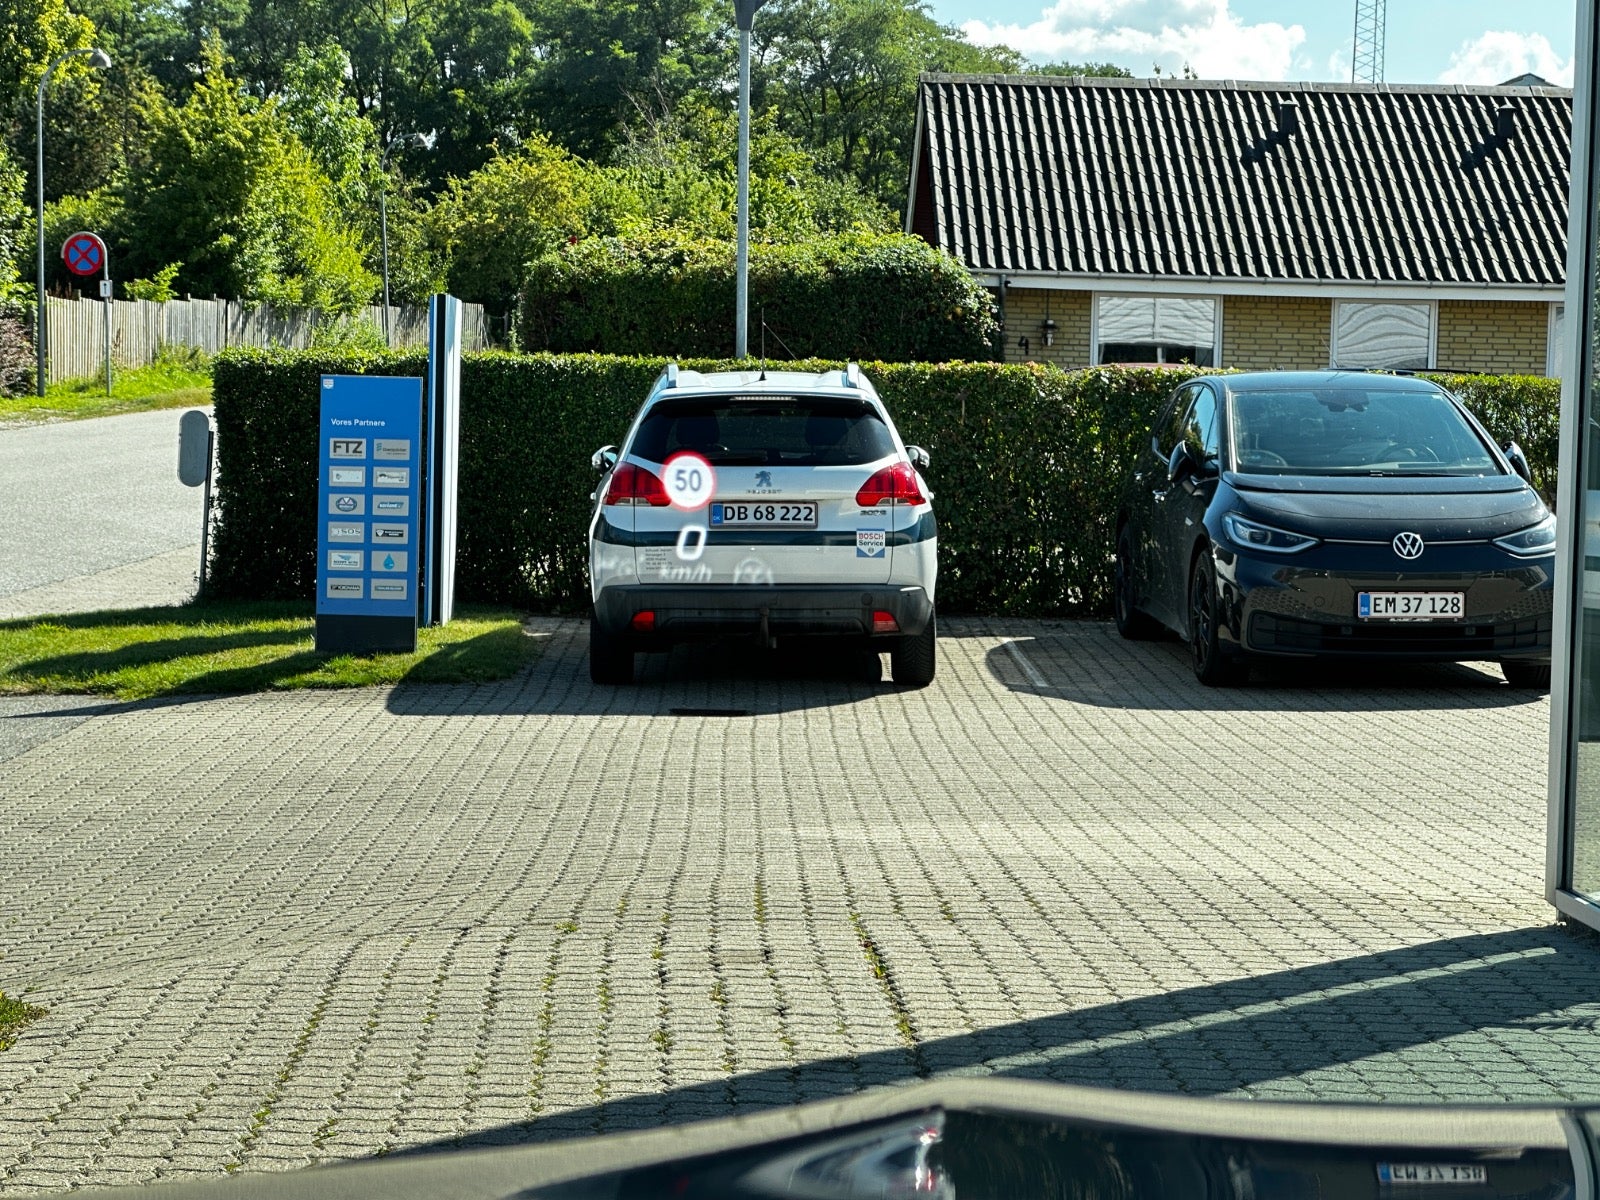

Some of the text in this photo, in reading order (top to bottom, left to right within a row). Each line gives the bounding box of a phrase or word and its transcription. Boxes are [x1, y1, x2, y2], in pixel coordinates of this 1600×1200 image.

[1018, 335, 1029, 356] 4
[330, 418, 386, 427] Vores Partnere
[333, 440, 363, 454] FTZ
[675, 469, 702, 492] 50
[724, 506, 813, 521] DB 68 222
[676, 525, 707, 561] 0
[1373, 597, 1461, 613] EM 37 128
